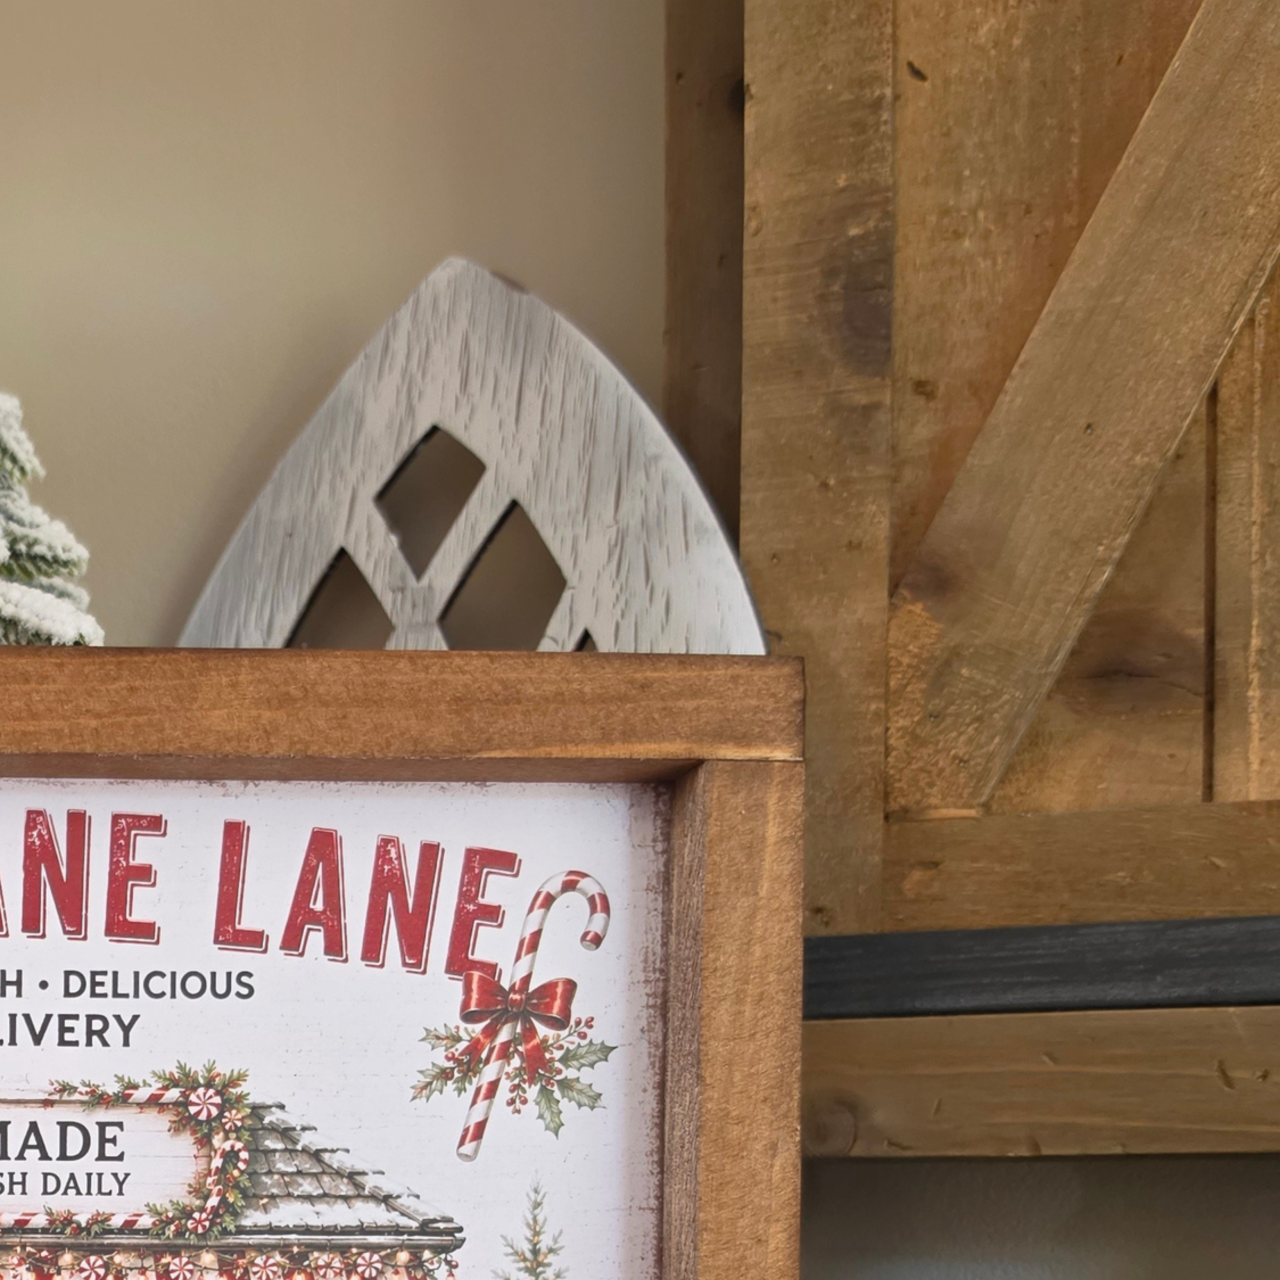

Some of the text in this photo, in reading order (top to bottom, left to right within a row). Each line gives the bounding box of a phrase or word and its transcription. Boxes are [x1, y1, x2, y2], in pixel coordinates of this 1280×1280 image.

[213, 818, 521, 982] LANE
[63, 970, 255, 1000] DELICIOUS
[41, 1172, 131, 1197] DAILY
